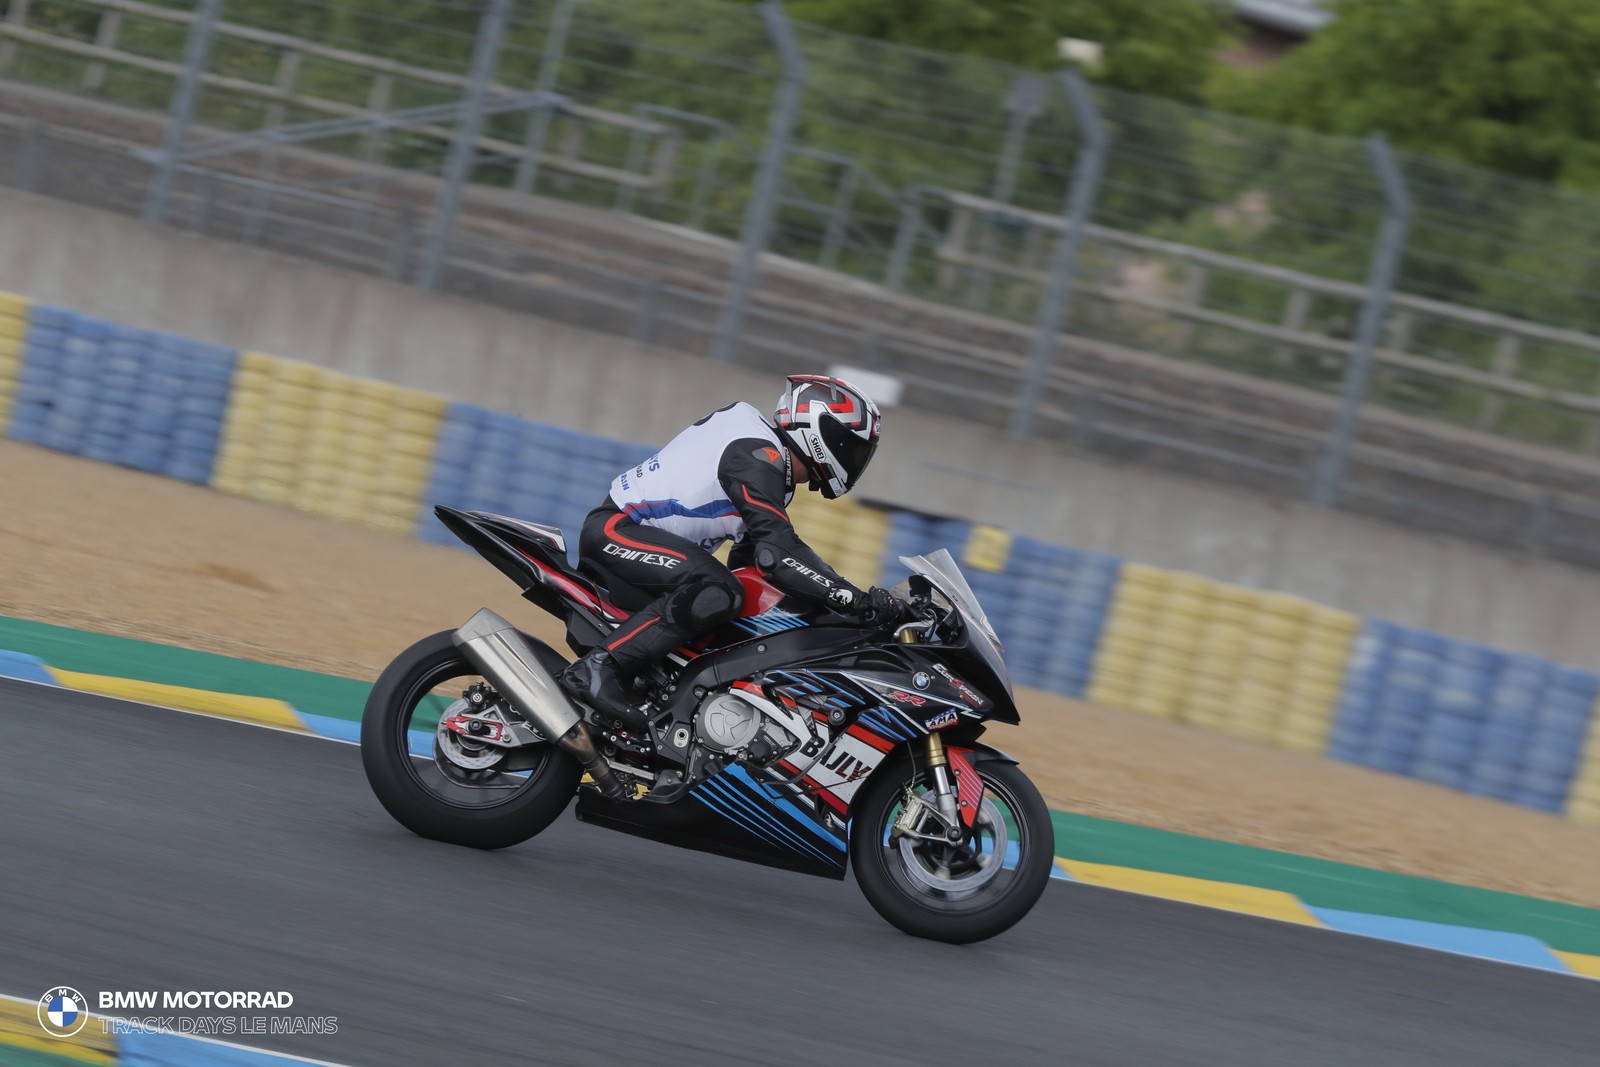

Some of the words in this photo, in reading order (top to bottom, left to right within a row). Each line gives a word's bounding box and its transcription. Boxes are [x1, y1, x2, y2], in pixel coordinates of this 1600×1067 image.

[810, 437, 825, 460] SHOEI
[602, 543, 681, 569] DAINESE
[781, 557, 834, 587] DAINES
[887, 690, 926, 707] RR
[928, 711, 957, 727] AMA
